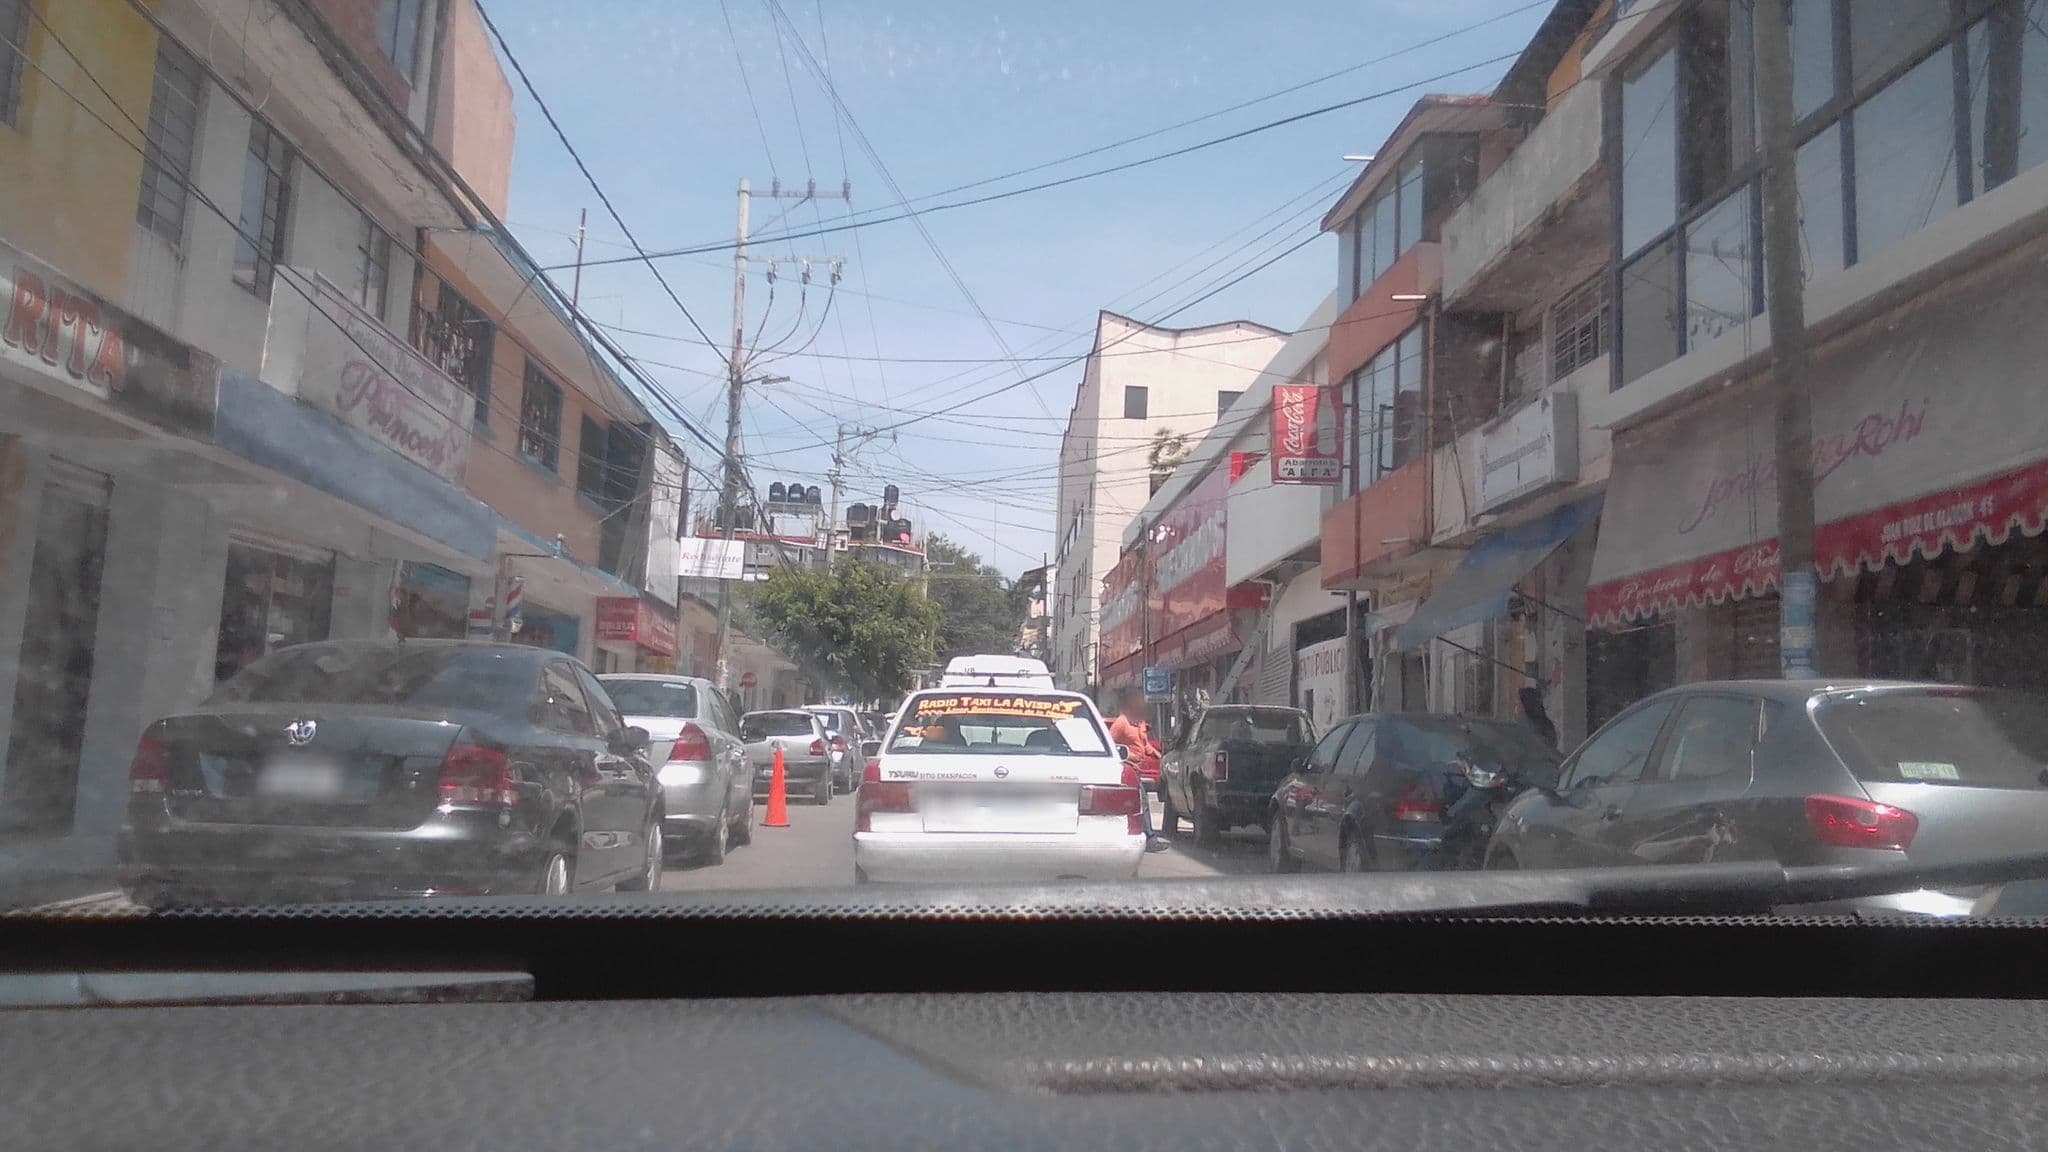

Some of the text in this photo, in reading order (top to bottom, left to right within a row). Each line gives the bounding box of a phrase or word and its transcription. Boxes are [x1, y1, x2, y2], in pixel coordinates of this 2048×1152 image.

[4, 266, 125, 392] RITA
[917, 699, 958, 711] RADIO
[960, 696, 992, 708] TAXI
[993, 698, 1012, 708] LA
[888, 770, 919, 778] TSURU
